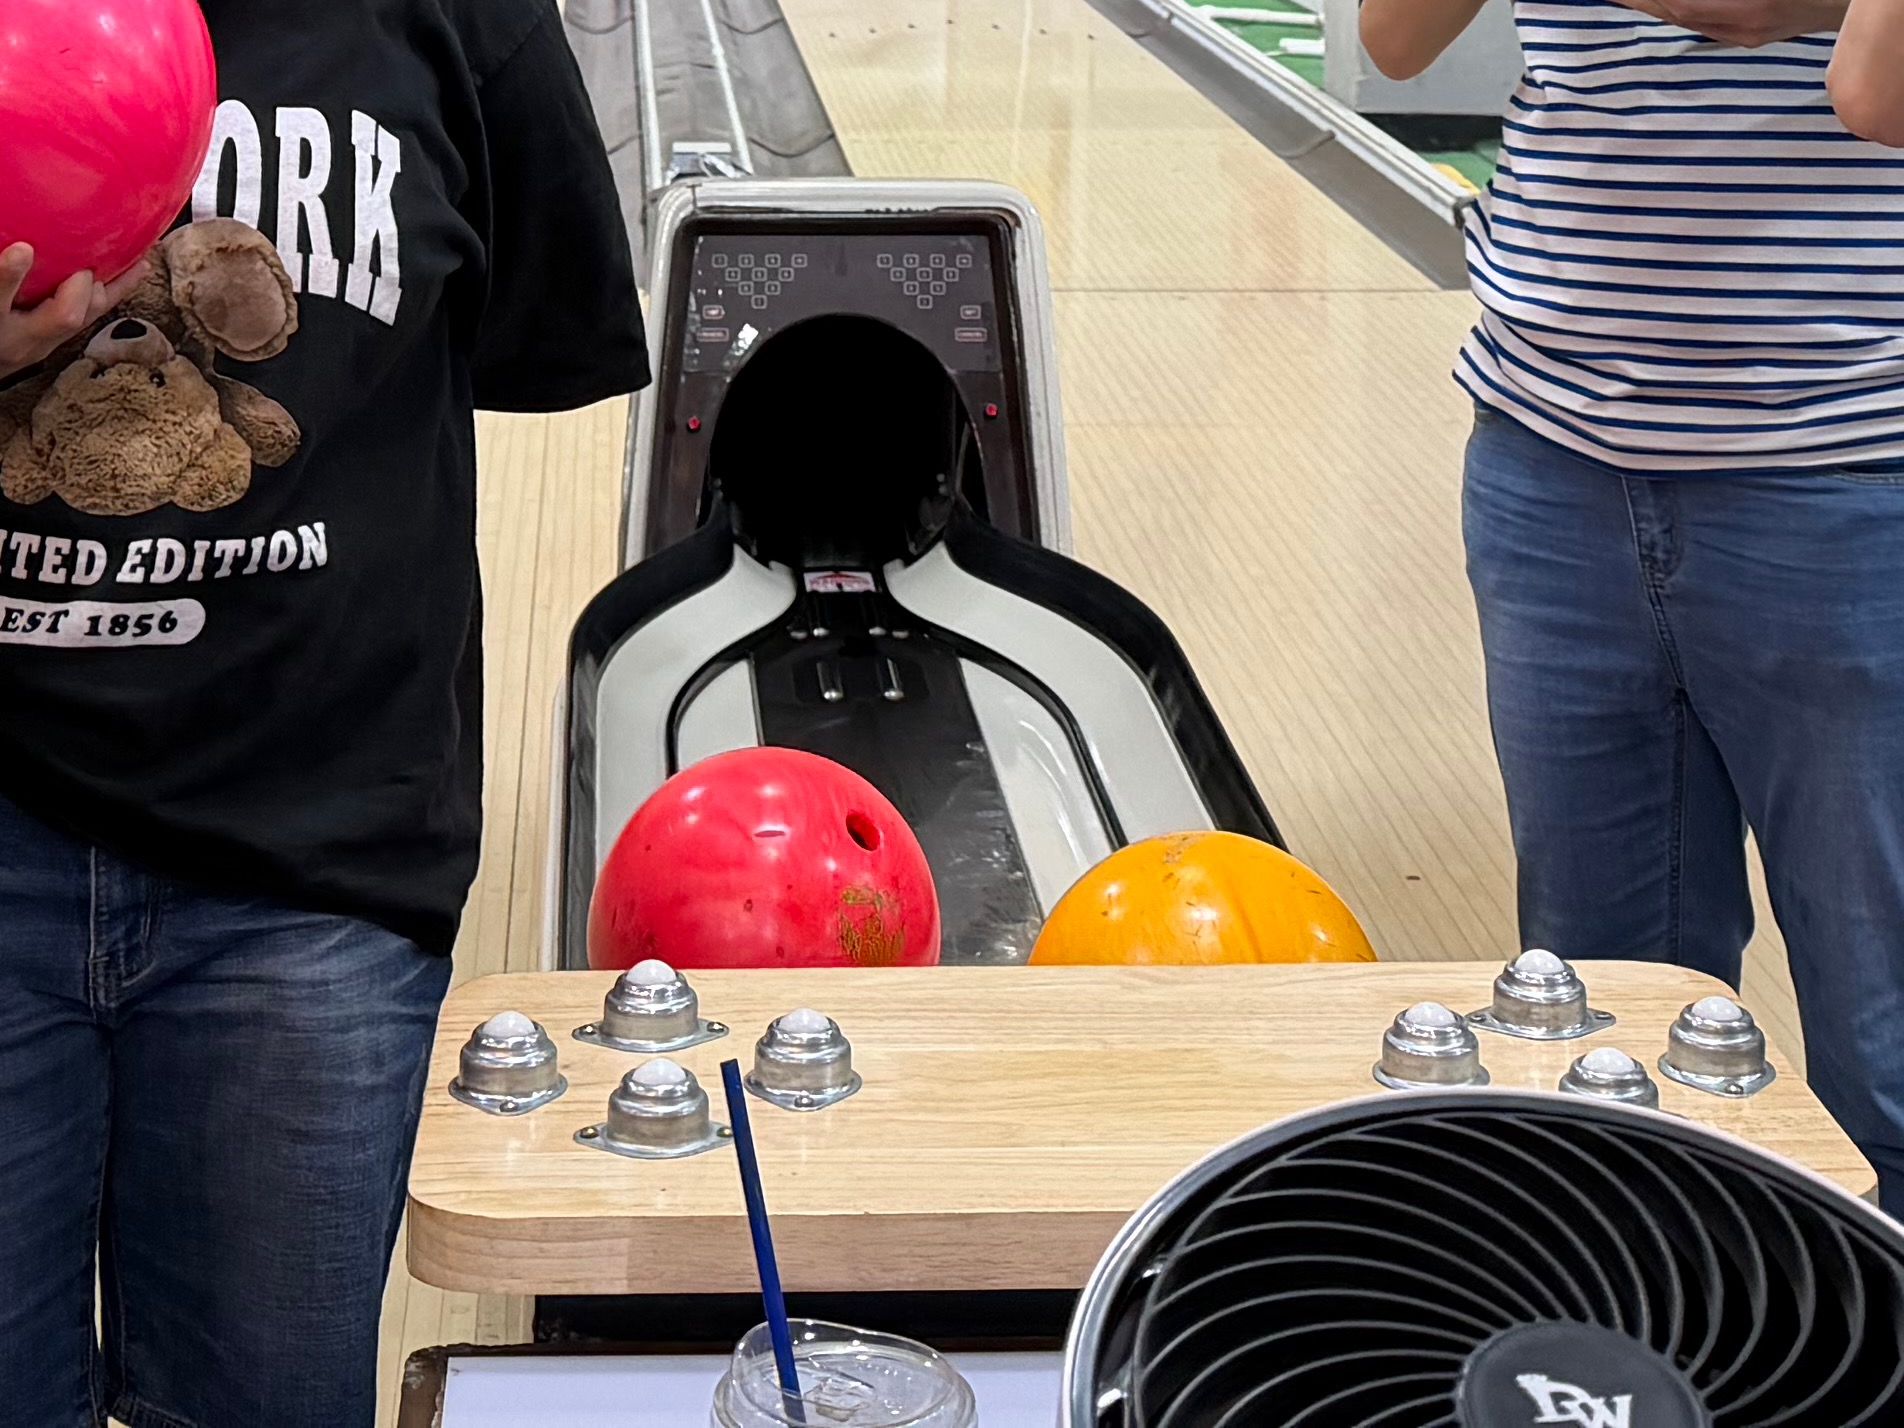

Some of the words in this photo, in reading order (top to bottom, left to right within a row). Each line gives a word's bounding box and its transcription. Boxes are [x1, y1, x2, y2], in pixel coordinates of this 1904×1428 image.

[191, 98, 404, 328] ORK
[115, 521, 329, 585] EDITION
[83, 607, 180, 640] 1856
